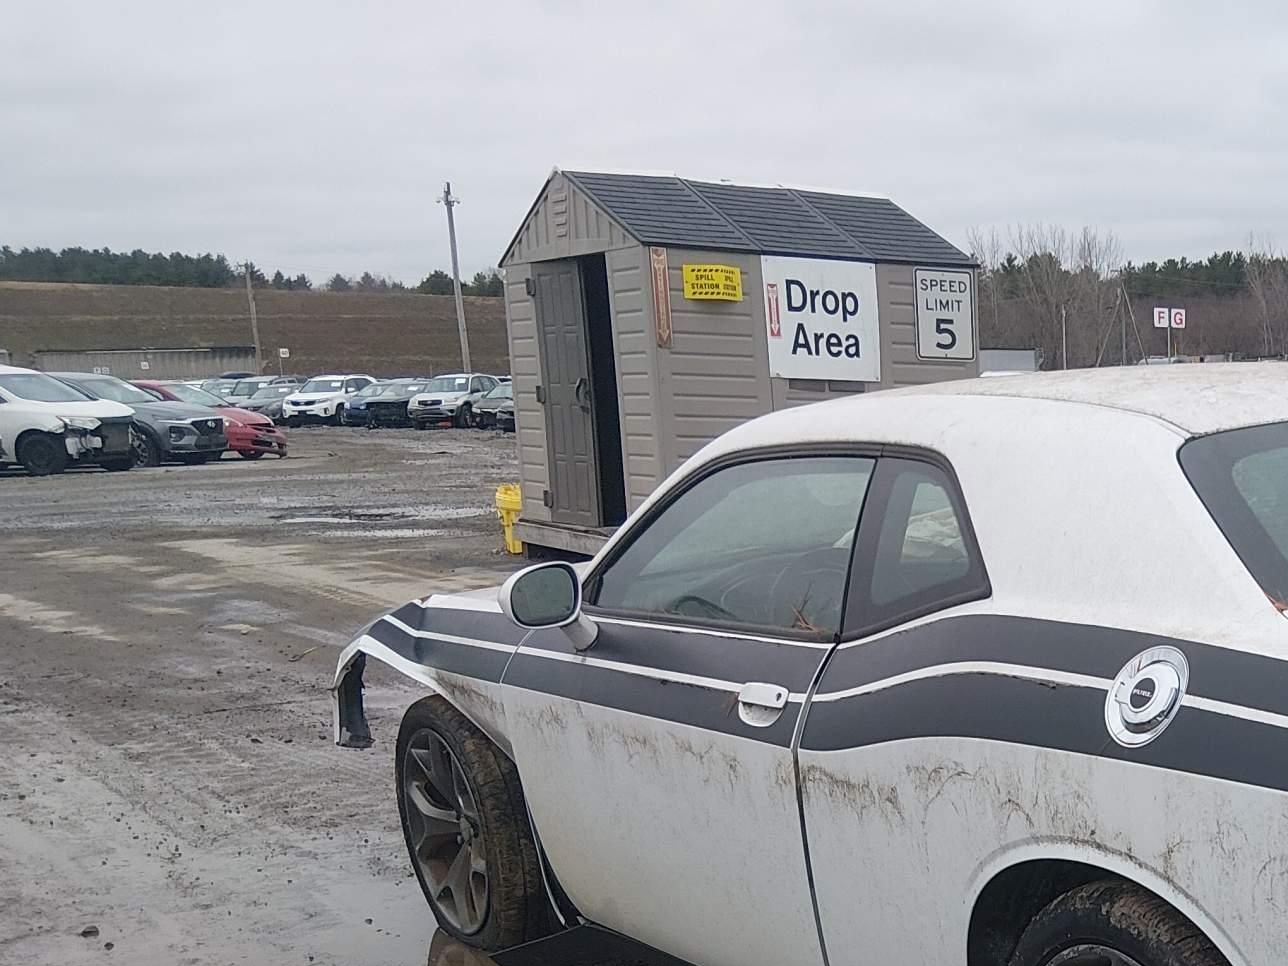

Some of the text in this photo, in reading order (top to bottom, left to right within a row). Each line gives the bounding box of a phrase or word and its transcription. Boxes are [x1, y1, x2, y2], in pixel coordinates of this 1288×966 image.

[920, 278, 967, 293] SPEED
[785, 279, 859, 322] Drop
[925, 298, 963, 312] LIMIT
[1158, 311, 1165, 324] F
[1174, 312, 1183, 325] G
[792, 322, 860, 358] Area
[935, 318, 957, 350] 5
